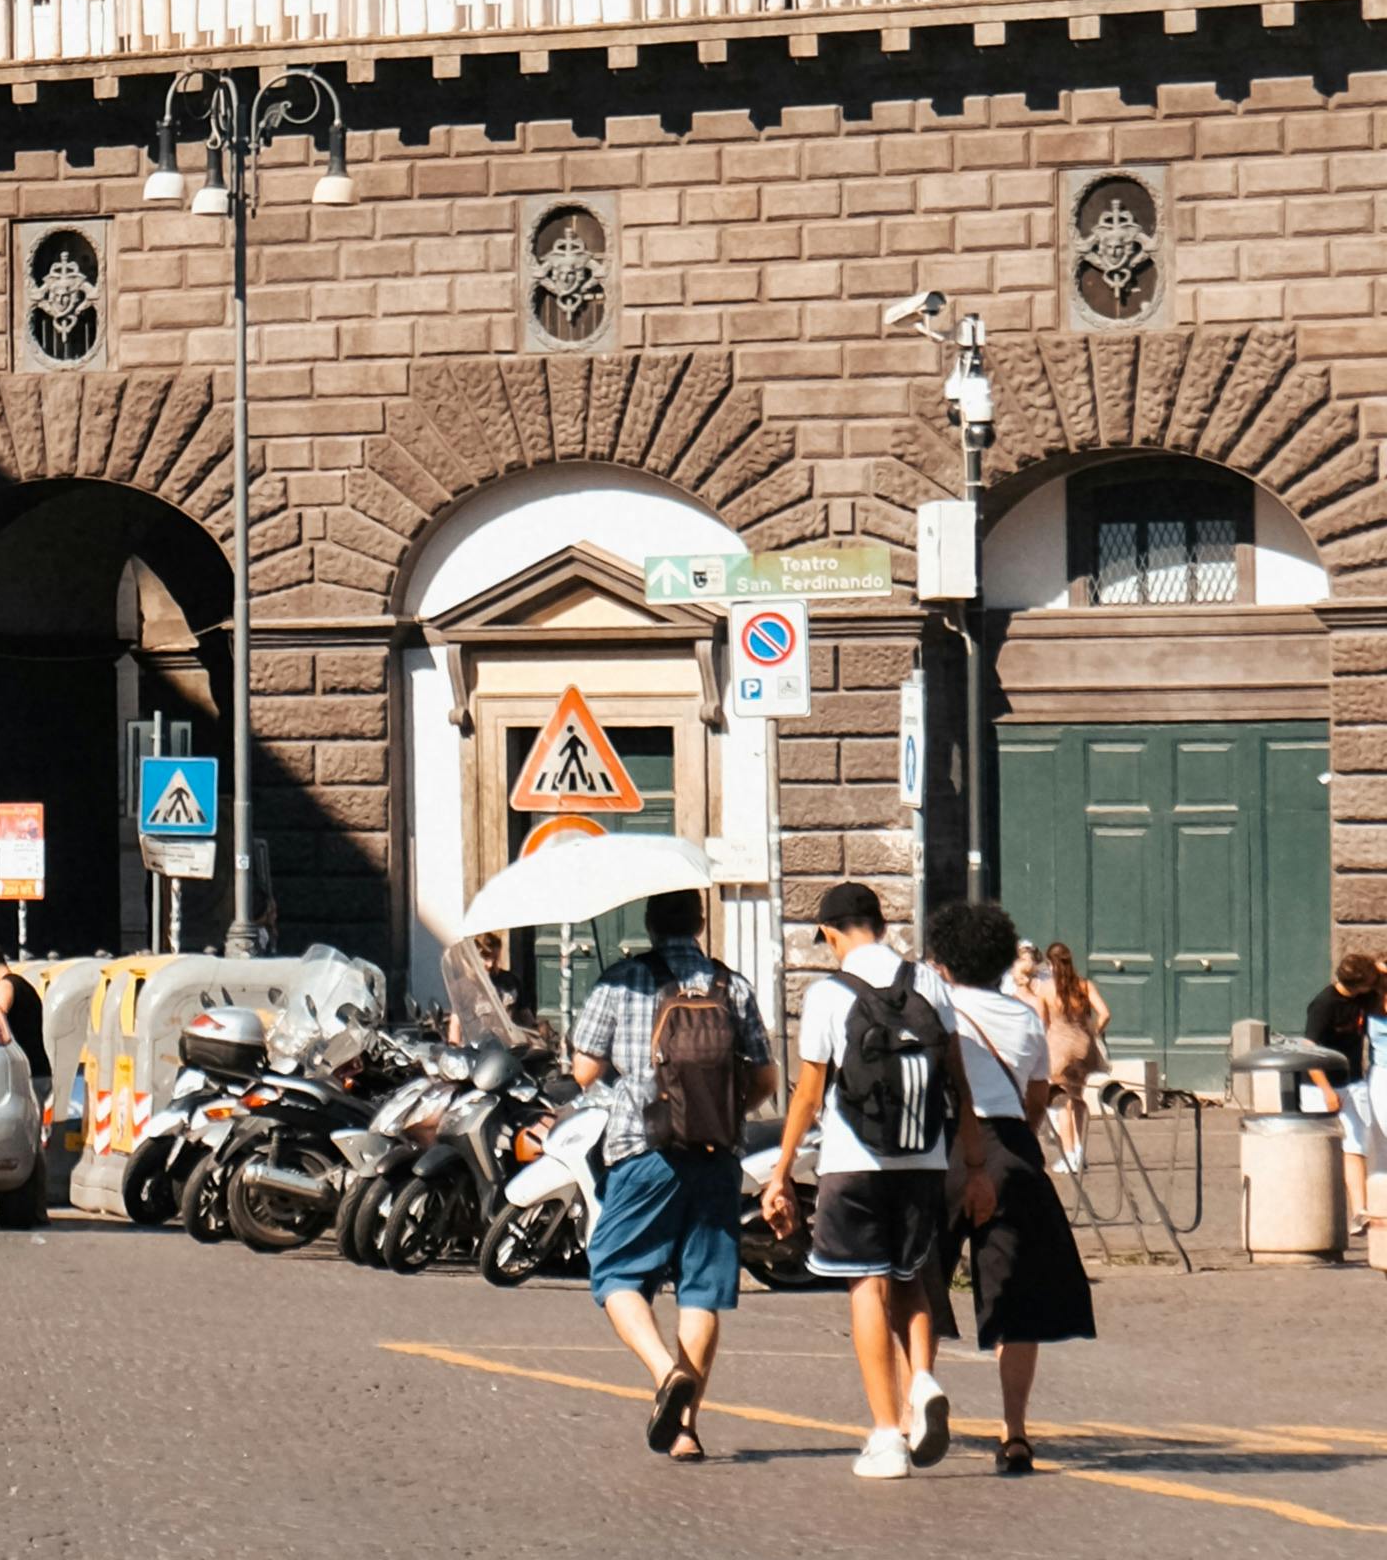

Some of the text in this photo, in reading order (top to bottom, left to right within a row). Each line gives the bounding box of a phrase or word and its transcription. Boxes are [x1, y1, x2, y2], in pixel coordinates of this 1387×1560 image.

[779, 556, 838, 573] Teatro
[736, 574, 884, 593] San Ferdinando
[744, 680, 760, 699] P
